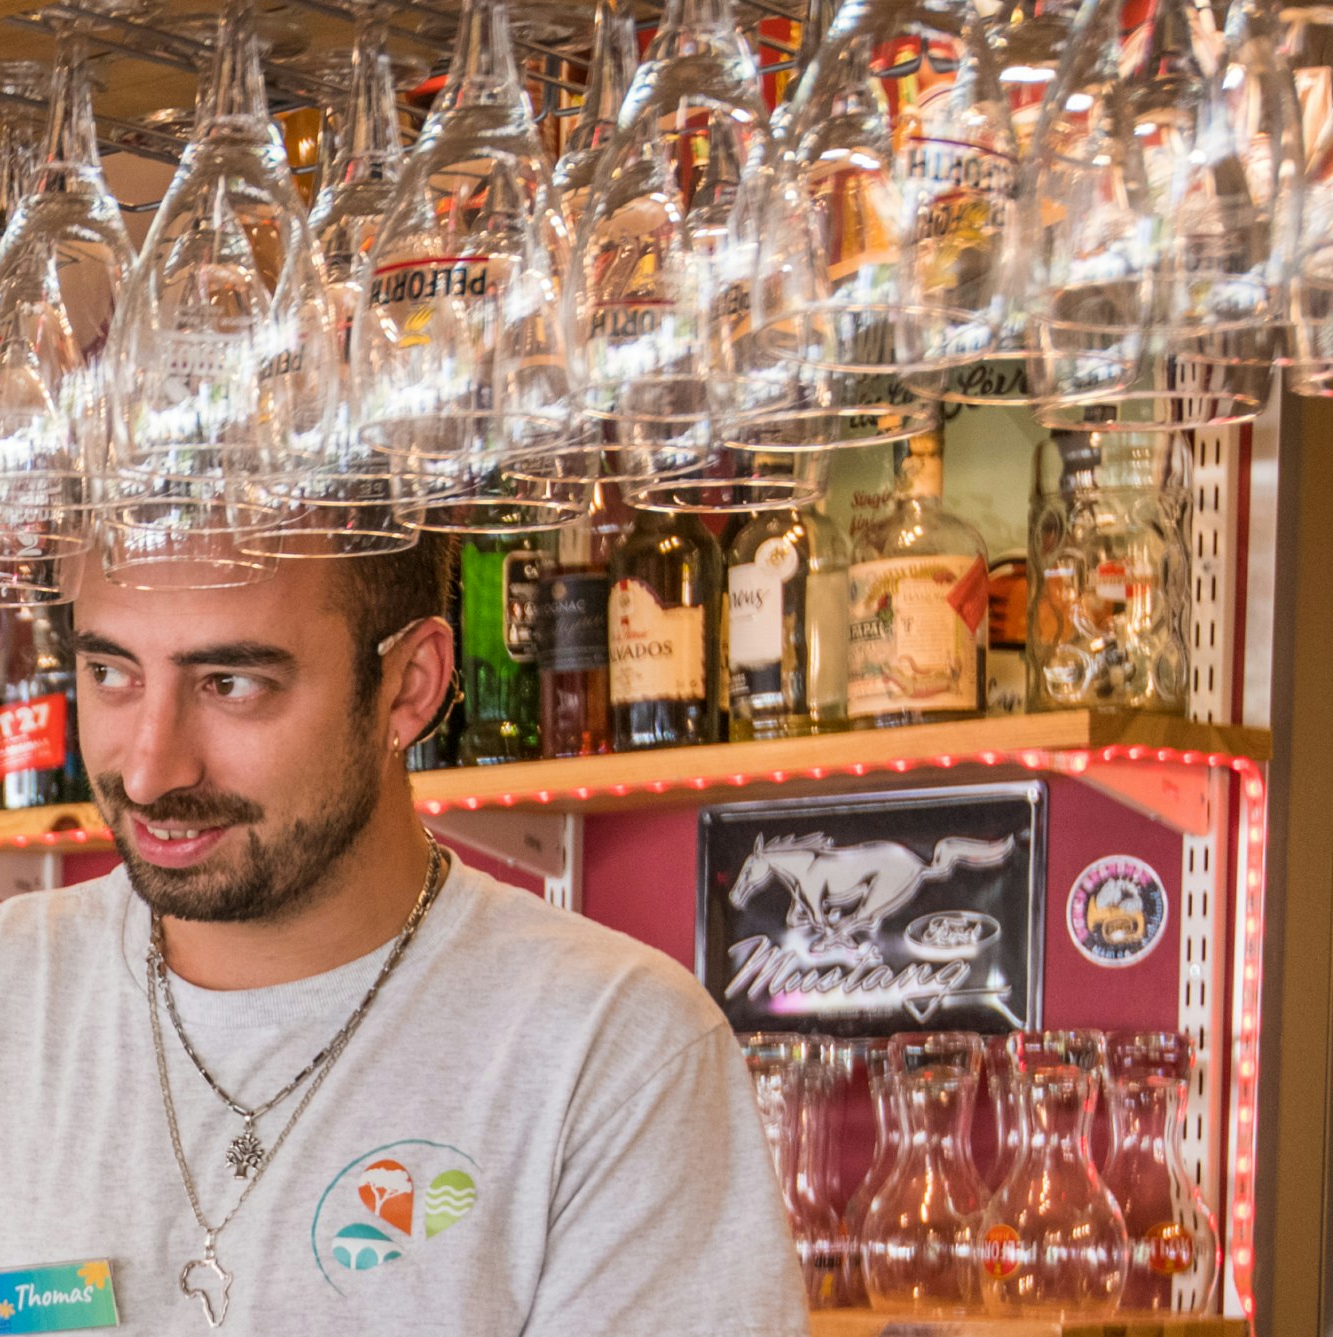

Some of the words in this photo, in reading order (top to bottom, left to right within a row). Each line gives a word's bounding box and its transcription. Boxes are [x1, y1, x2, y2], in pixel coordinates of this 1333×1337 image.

[15, 702, 49, 733] 27
[724, 934, 1011, 1023] Mustang
[14, 1283, 94, 1312] Thomas
